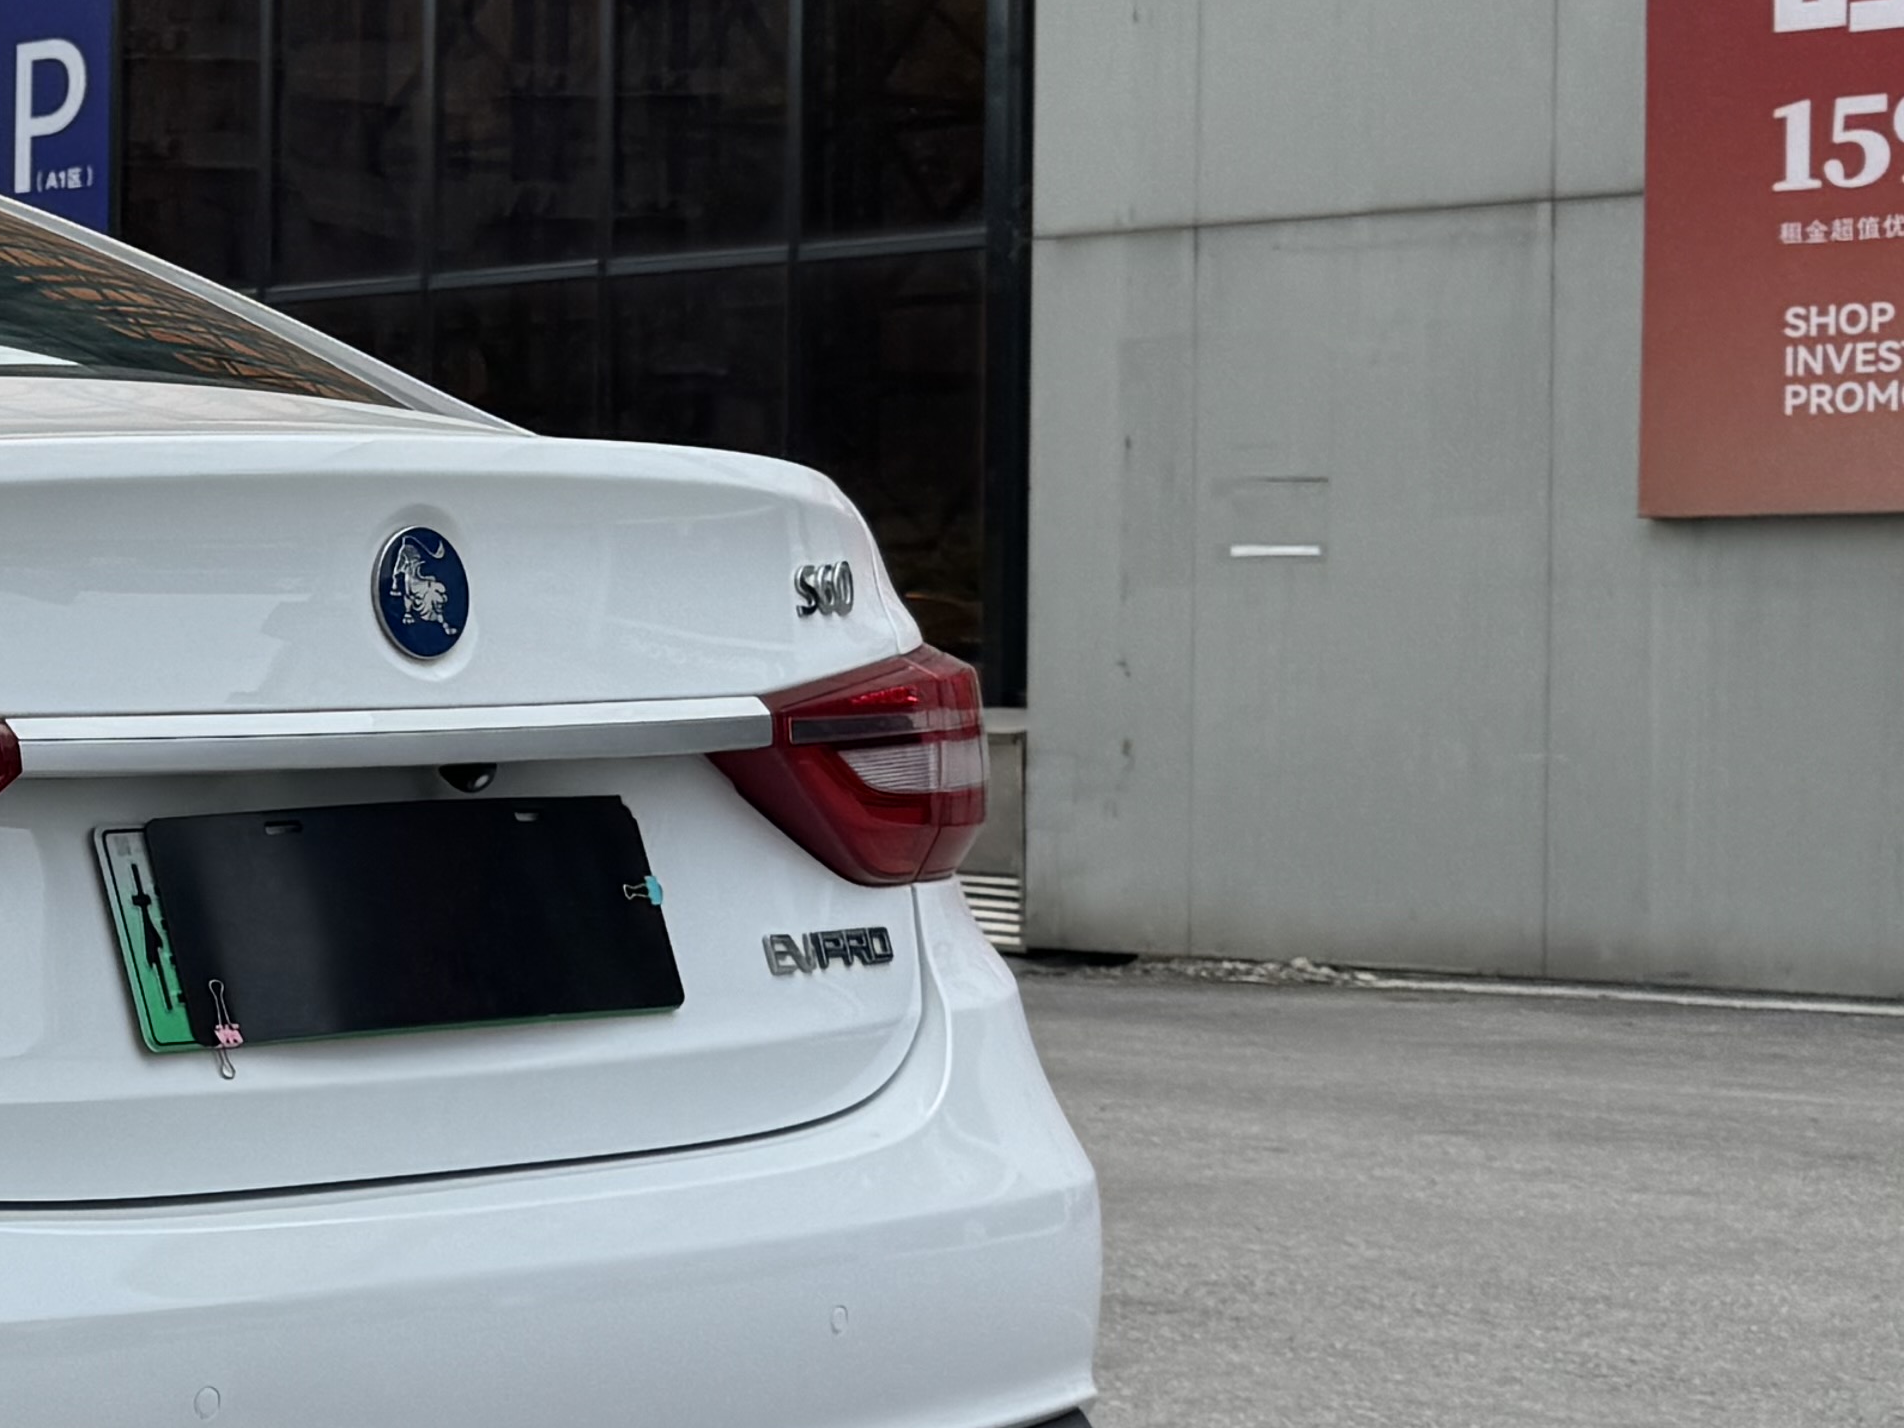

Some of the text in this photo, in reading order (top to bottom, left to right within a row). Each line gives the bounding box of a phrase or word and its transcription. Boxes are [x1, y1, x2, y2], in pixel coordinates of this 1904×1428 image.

[14, 38, 87, 194] P
[1772, 93, 1904, 192] 15
[1784, 301, 1895, 338] SHOP
[1785, 340, 1904, 377] INVES
[1784, 379, 1904, 416] PROM
